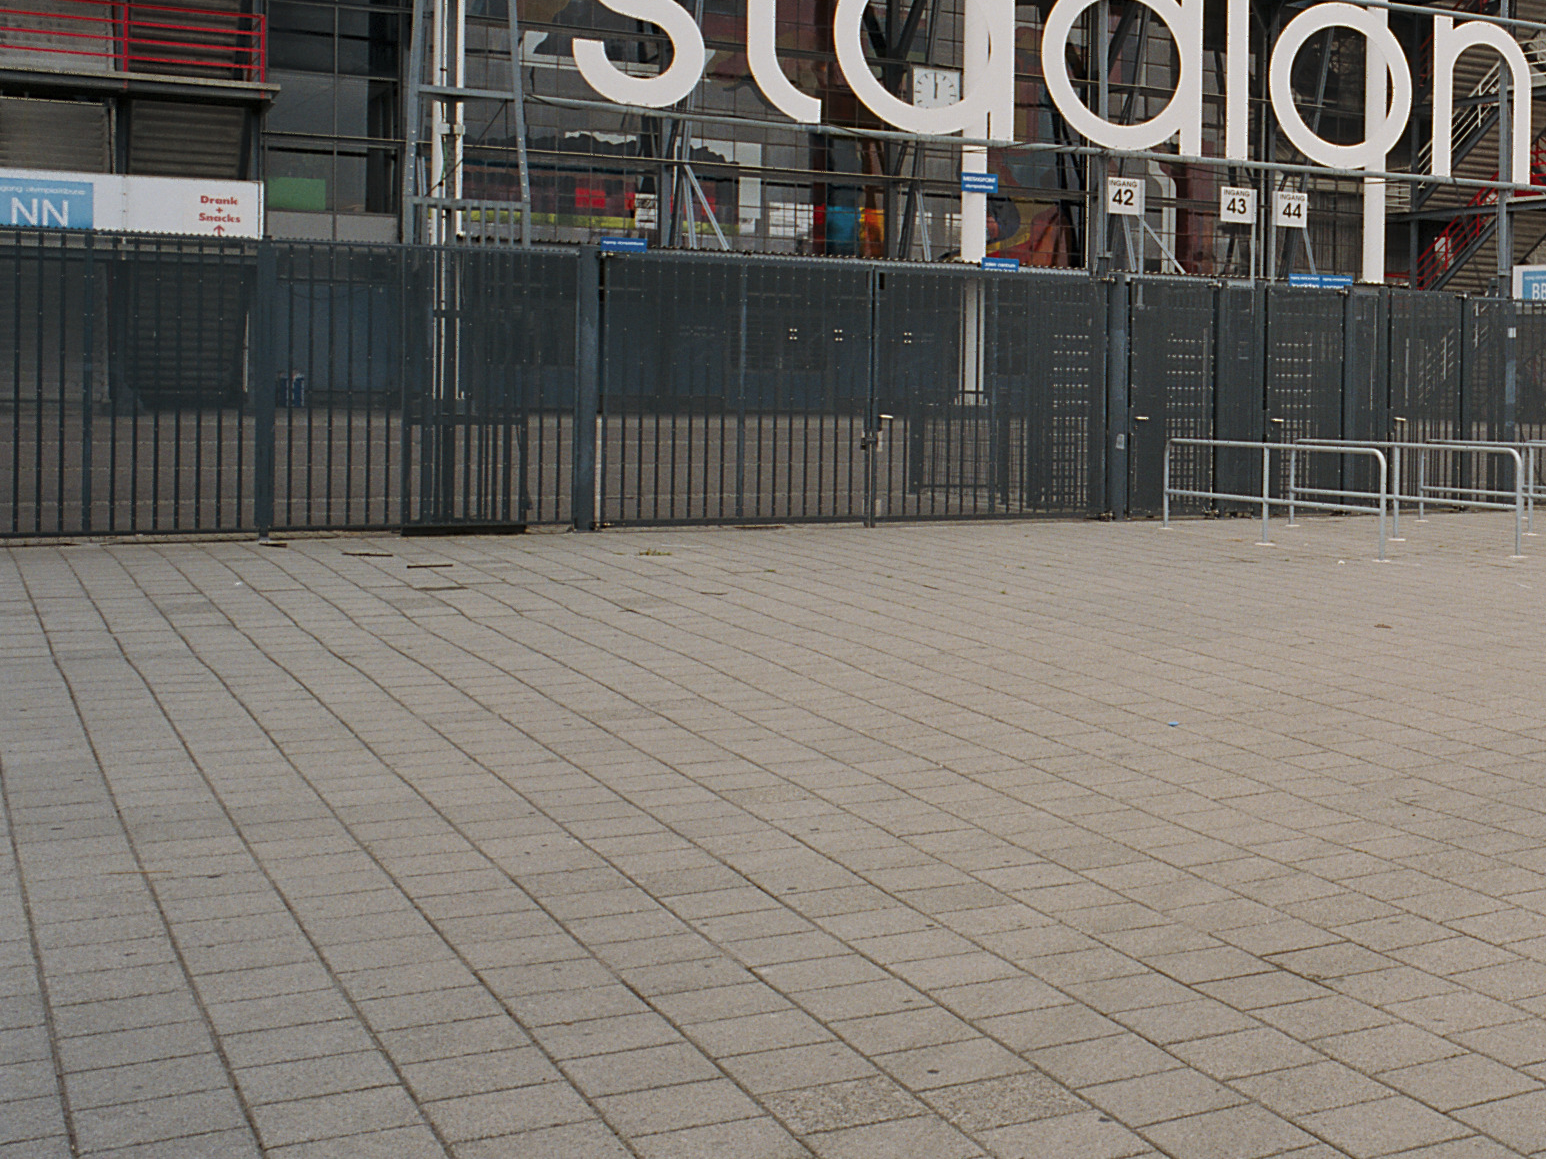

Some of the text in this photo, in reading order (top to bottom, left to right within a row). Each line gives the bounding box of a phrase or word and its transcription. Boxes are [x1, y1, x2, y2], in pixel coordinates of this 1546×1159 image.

[1109, 179, 1138, 188] INGANG
[1112, 189, 1134, 206] 42
[1224, 189, 1251, 197] INGANG
[1280, 194, 1305, 202] INGANG
[200, 195, 239, 206] Drank
[1226, 198, 1247, 215] 43
[11, 197, 69, 227] NN
[1282, 203, 1302, 219] 44
[199, 212, 241, 224] Snacks
